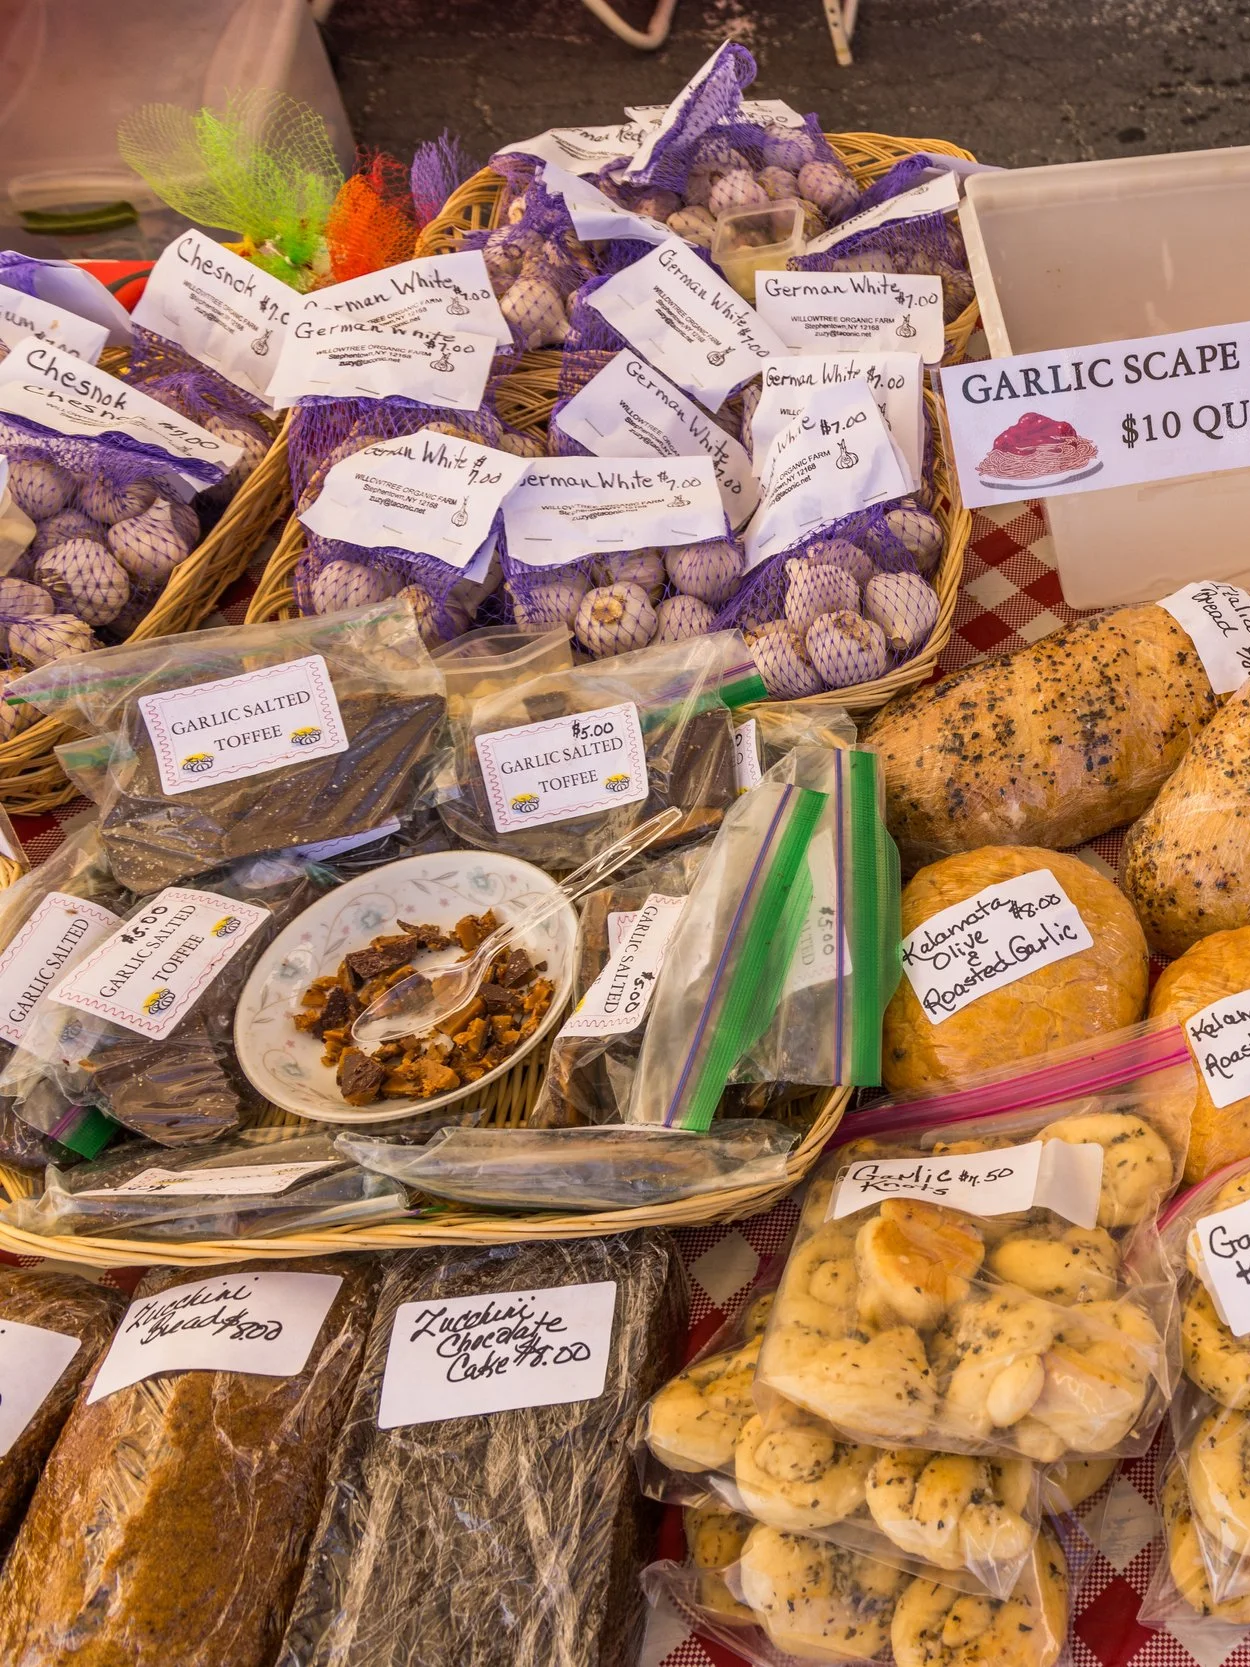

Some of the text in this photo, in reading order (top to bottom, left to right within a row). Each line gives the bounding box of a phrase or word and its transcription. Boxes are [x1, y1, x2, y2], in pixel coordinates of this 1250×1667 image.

[177, 238, 256, 297] Chesnok
[390, 269, 452, 295] White
[453, 284, 490, 301] $7.00
[658, 249, 708, 301] German
[710, 292, 748, 331] White
[737, 327, 770, 358] $7.00
[765, 275, 939, 309] German White $7.00
[295, 322, 384, 339] German
[652, 285, 688, 320] WILLOWTREE
[685, 315, 709, 338] ORGANIC
[707, 332, 722, 346] FARM
[791, 315, 839, 323] WILLOWTREE
[814, 330, 872, 338] zuzy@taconic.net
[316, 344, 366, 355] WILLOWTREE
[367, 344, 406, 354] ORGANIC
[424, 340, 475, 354] $7.00
[26, 349, 128, 410] Chesnok
[766, 366, 816, 387] German
[866, 365, 905, 389] $7.00
[961, 357, 1115, 406] GARLIC
[1123, 340, 1241, 384] SCAPE
[619, 400, 663, 436] WILLOWTREE
[626, 360, 686, 423] German
[689, 415, 729, 465] White
[820, 411, 867, 436] $7.00
[1121, 409, 1184, 449] $10
[421, 440, 468, 469] White
[778, 450, 831, 480] ORGANIC FARM
[796, 463, 817, 478] 12168
[354, 472, 458, 506] WILLOWTREE ORGANIC FARM
[597, 470, 654, 490] White
[657, 471, 702, 491] $7.00
[368, 495, 427, 515] zuzy@taconic.net
[418, 499, 439, 509] 12168
[1192, 588, 1238, 638] Bread
[171, 690, 311, 736] GARLIC SALTED
[571, 719, 614, 740] $5.00
[213, 725, 283, 751] TOFFEE
[501, 737, 623, 776] GARLIC SALTED
[538, 768, 599, 793] TOFFEE
[120, 906, 168, 945] $5.00
[818, 906, 835, 956] $5.00
[902, 894, 1061, 966] Kalamata $8.00
[99, 905, 196, 998] GARLIC SALTED
[151, 934, 205, 984] TOFFEE
[604, 906, 658, 1014] GARLIC SALTED
[923, 923, 1077, 1015] Roasted Garlic
[933, 931, 989, 970] Olive
[9, 918, 89, 1023] GARLIC SALTED
[625, 971, 655, 1013] $5.00
[852, 1164, 1014, 1187] Garlic $7.50
[861, 1181, 950, 1195] Knots
[125, 1277, 259, 1333] Zucchini
[410, 1296, 535, 1342] Zucchini
[140, 1306, 283, 1345] Bread $8.00
[436, 1311, 568, 1358] Chocolate
[447, 1334, 591, 1383] Cake $8.00
